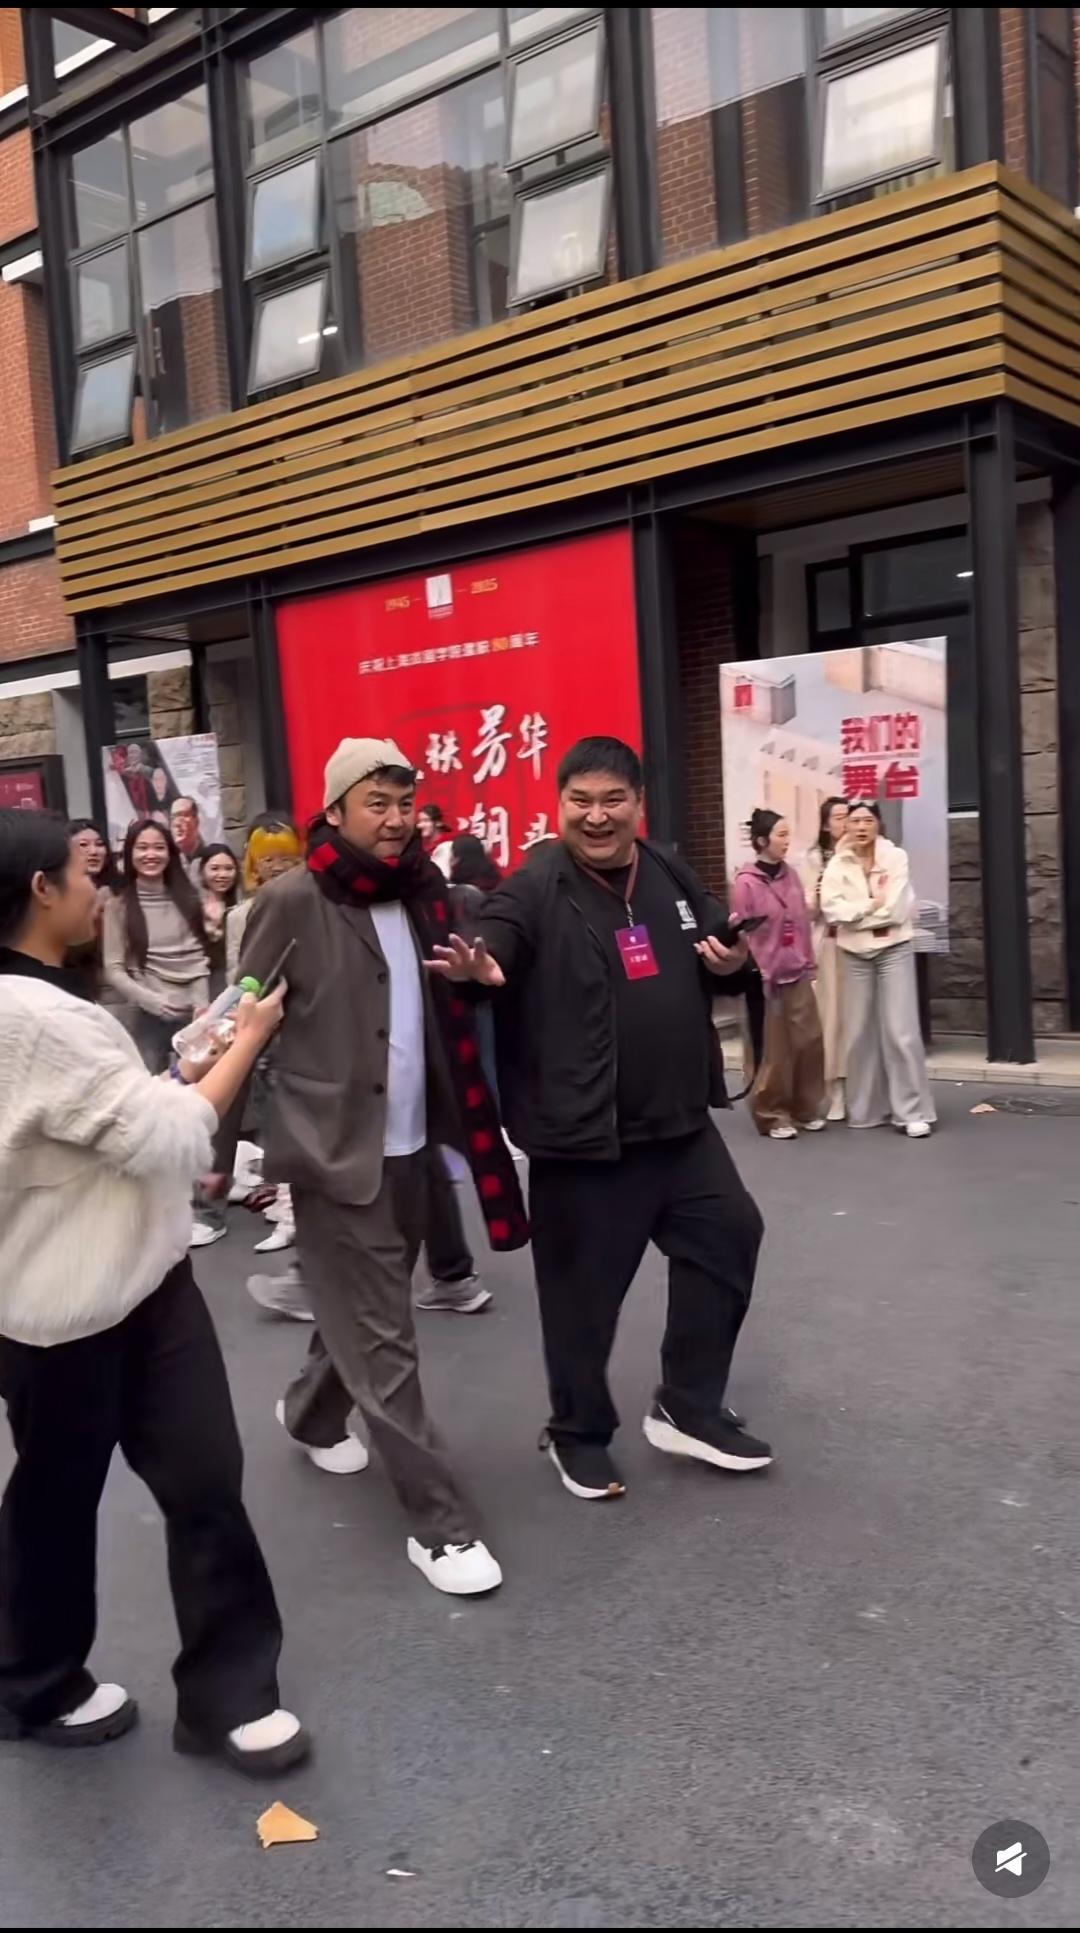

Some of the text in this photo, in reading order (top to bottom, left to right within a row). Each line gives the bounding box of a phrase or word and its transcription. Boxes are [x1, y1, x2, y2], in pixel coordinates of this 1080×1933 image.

[416, 704, 548, 784] 秩芳华
[841, 712, 919, 754] 我们的
[842, 761, 919, 800] 舞台
